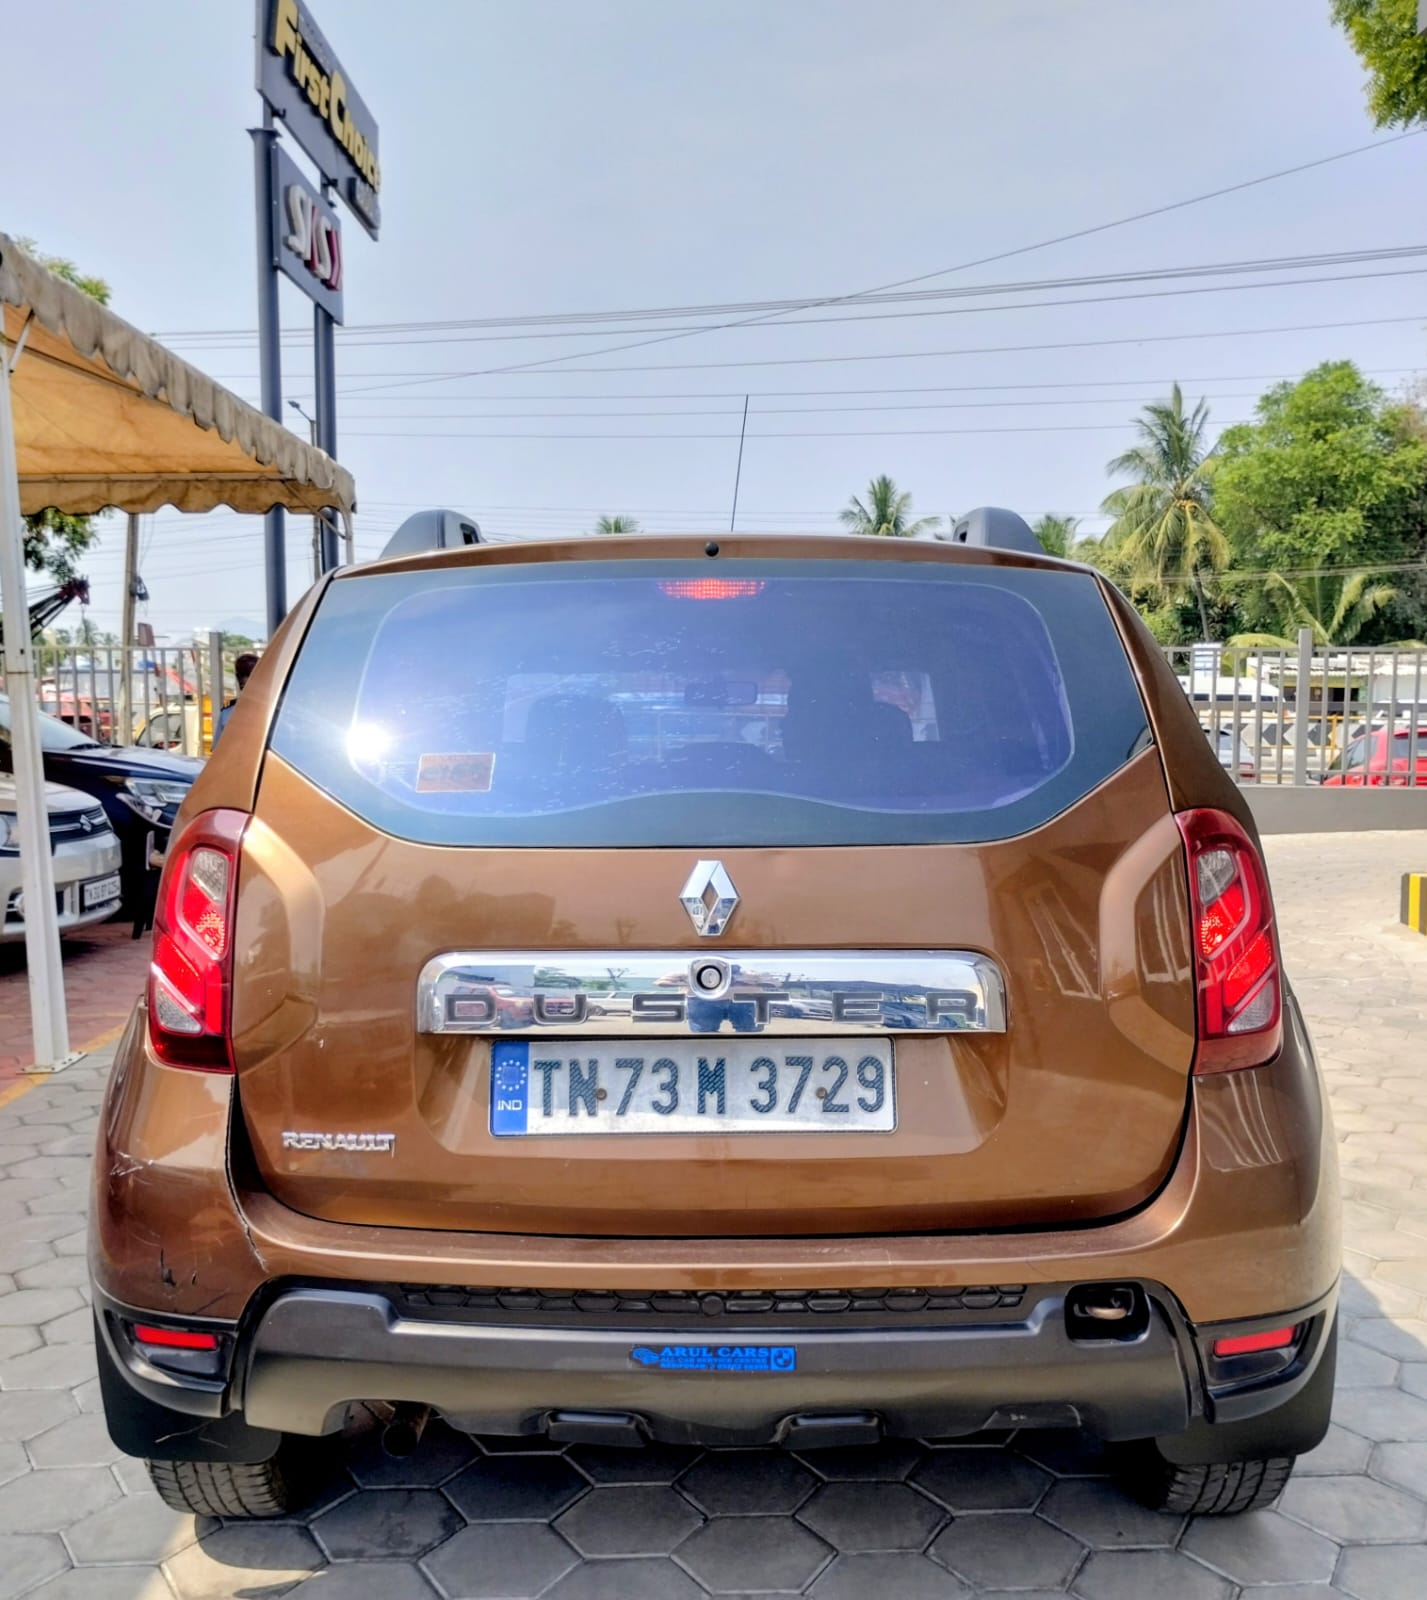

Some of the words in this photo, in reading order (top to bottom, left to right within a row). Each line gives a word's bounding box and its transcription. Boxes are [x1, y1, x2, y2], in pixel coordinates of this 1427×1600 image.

[444, 993, 978, 1025] DUSTER
[534, 1060, 597, 1116] TN
[615, 1057, 679, 1116] 73
[697, 1057, 726, 1114] M
[750, 1056, 884, 1113] 3729
[497, 1100, 522, 1111] IND
[281, 1131, 396, 1152] RENAULT
[660, 1346, 713, 1357] ARUL
[718, 1346, 769, 1357] CARS
